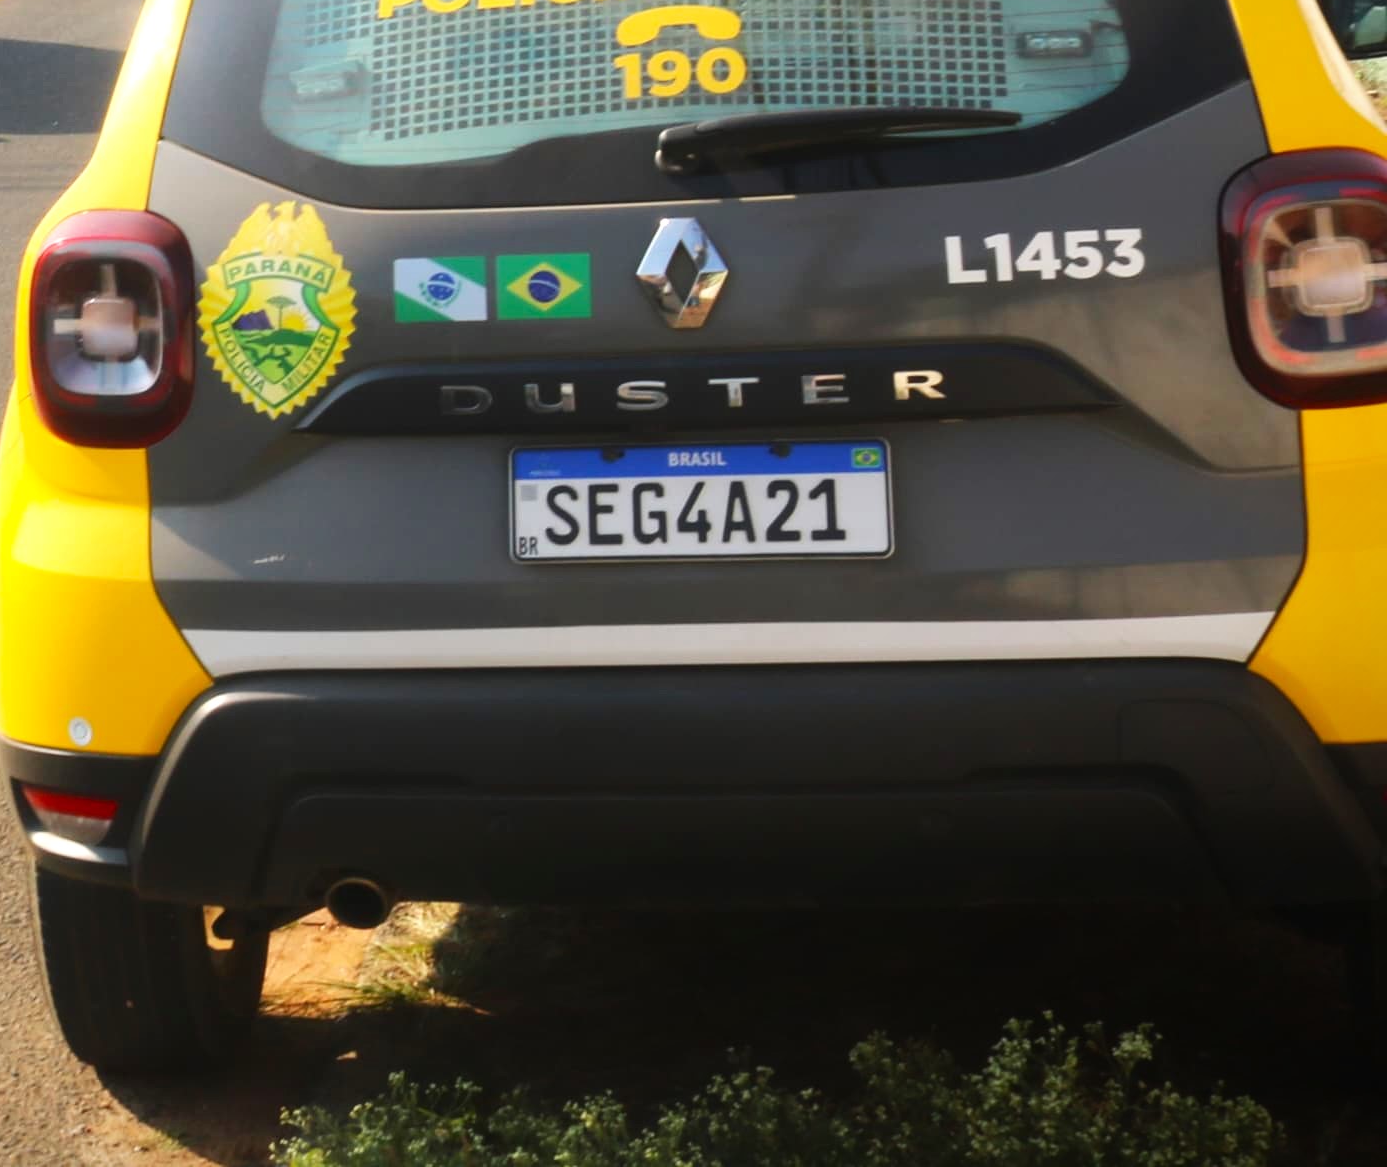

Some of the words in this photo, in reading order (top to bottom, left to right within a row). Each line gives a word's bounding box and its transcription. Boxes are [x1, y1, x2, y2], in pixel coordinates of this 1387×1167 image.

[614, 47, 748, 100] 190
[228, 258, 327, 283] PARANÁ
[944, 228, 1146, 284] L1453
[281, 332, 333, 392] MILITAR
[439, 369, 947, 415] DUSTER
[667, 451, 727, 467] BRASIL
[544, 478, 847, 547] SEG4A21
[518, 536, 539, 556] BR
